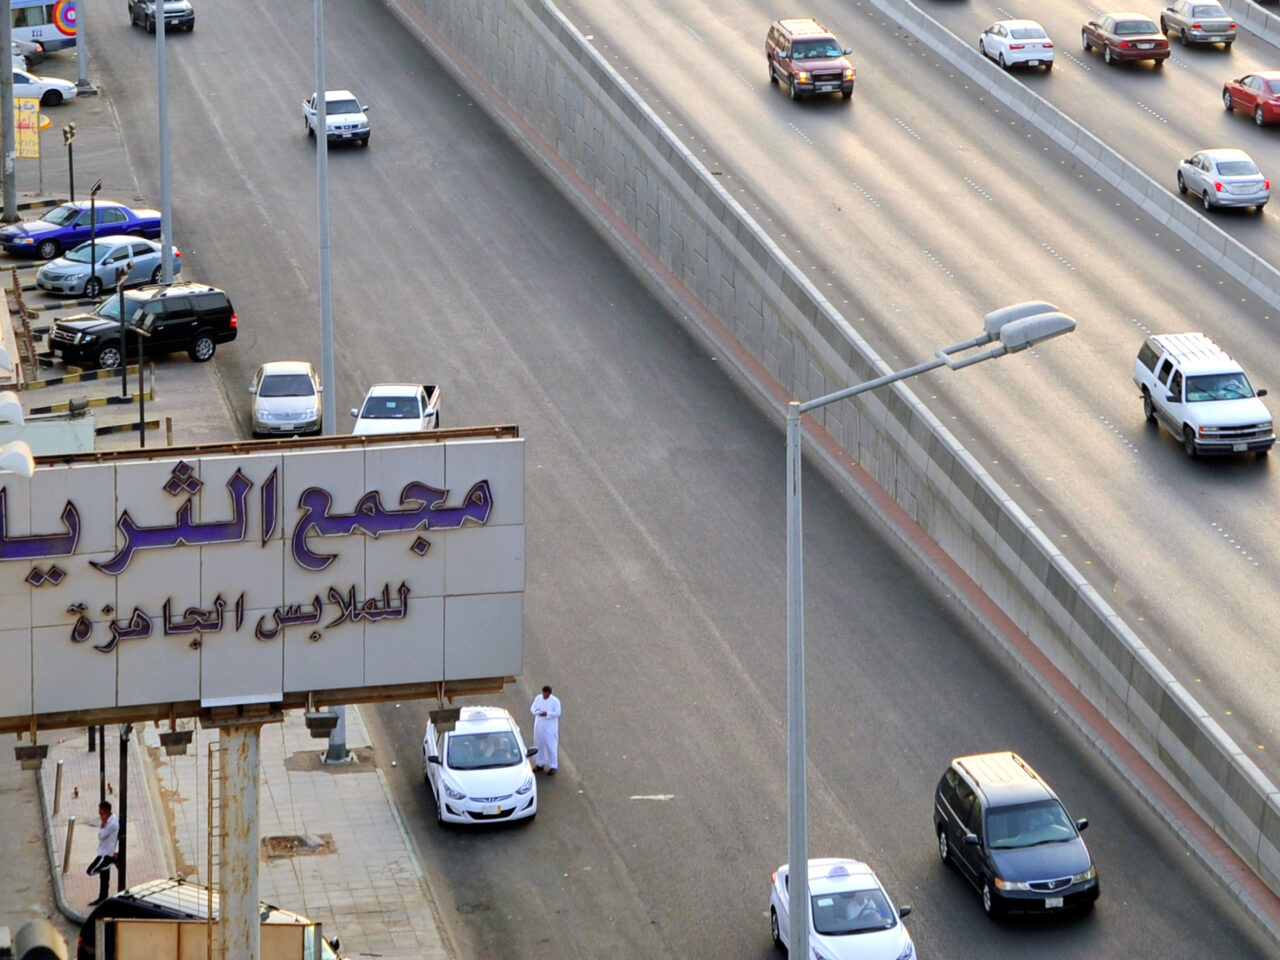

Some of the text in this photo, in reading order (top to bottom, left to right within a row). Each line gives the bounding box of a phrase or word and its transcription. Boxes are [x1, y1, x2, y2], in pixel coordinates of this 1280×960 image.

[292, 478, 494, 571] مجمع
[66, 580, 411, 653] للملابس الجاهزة
